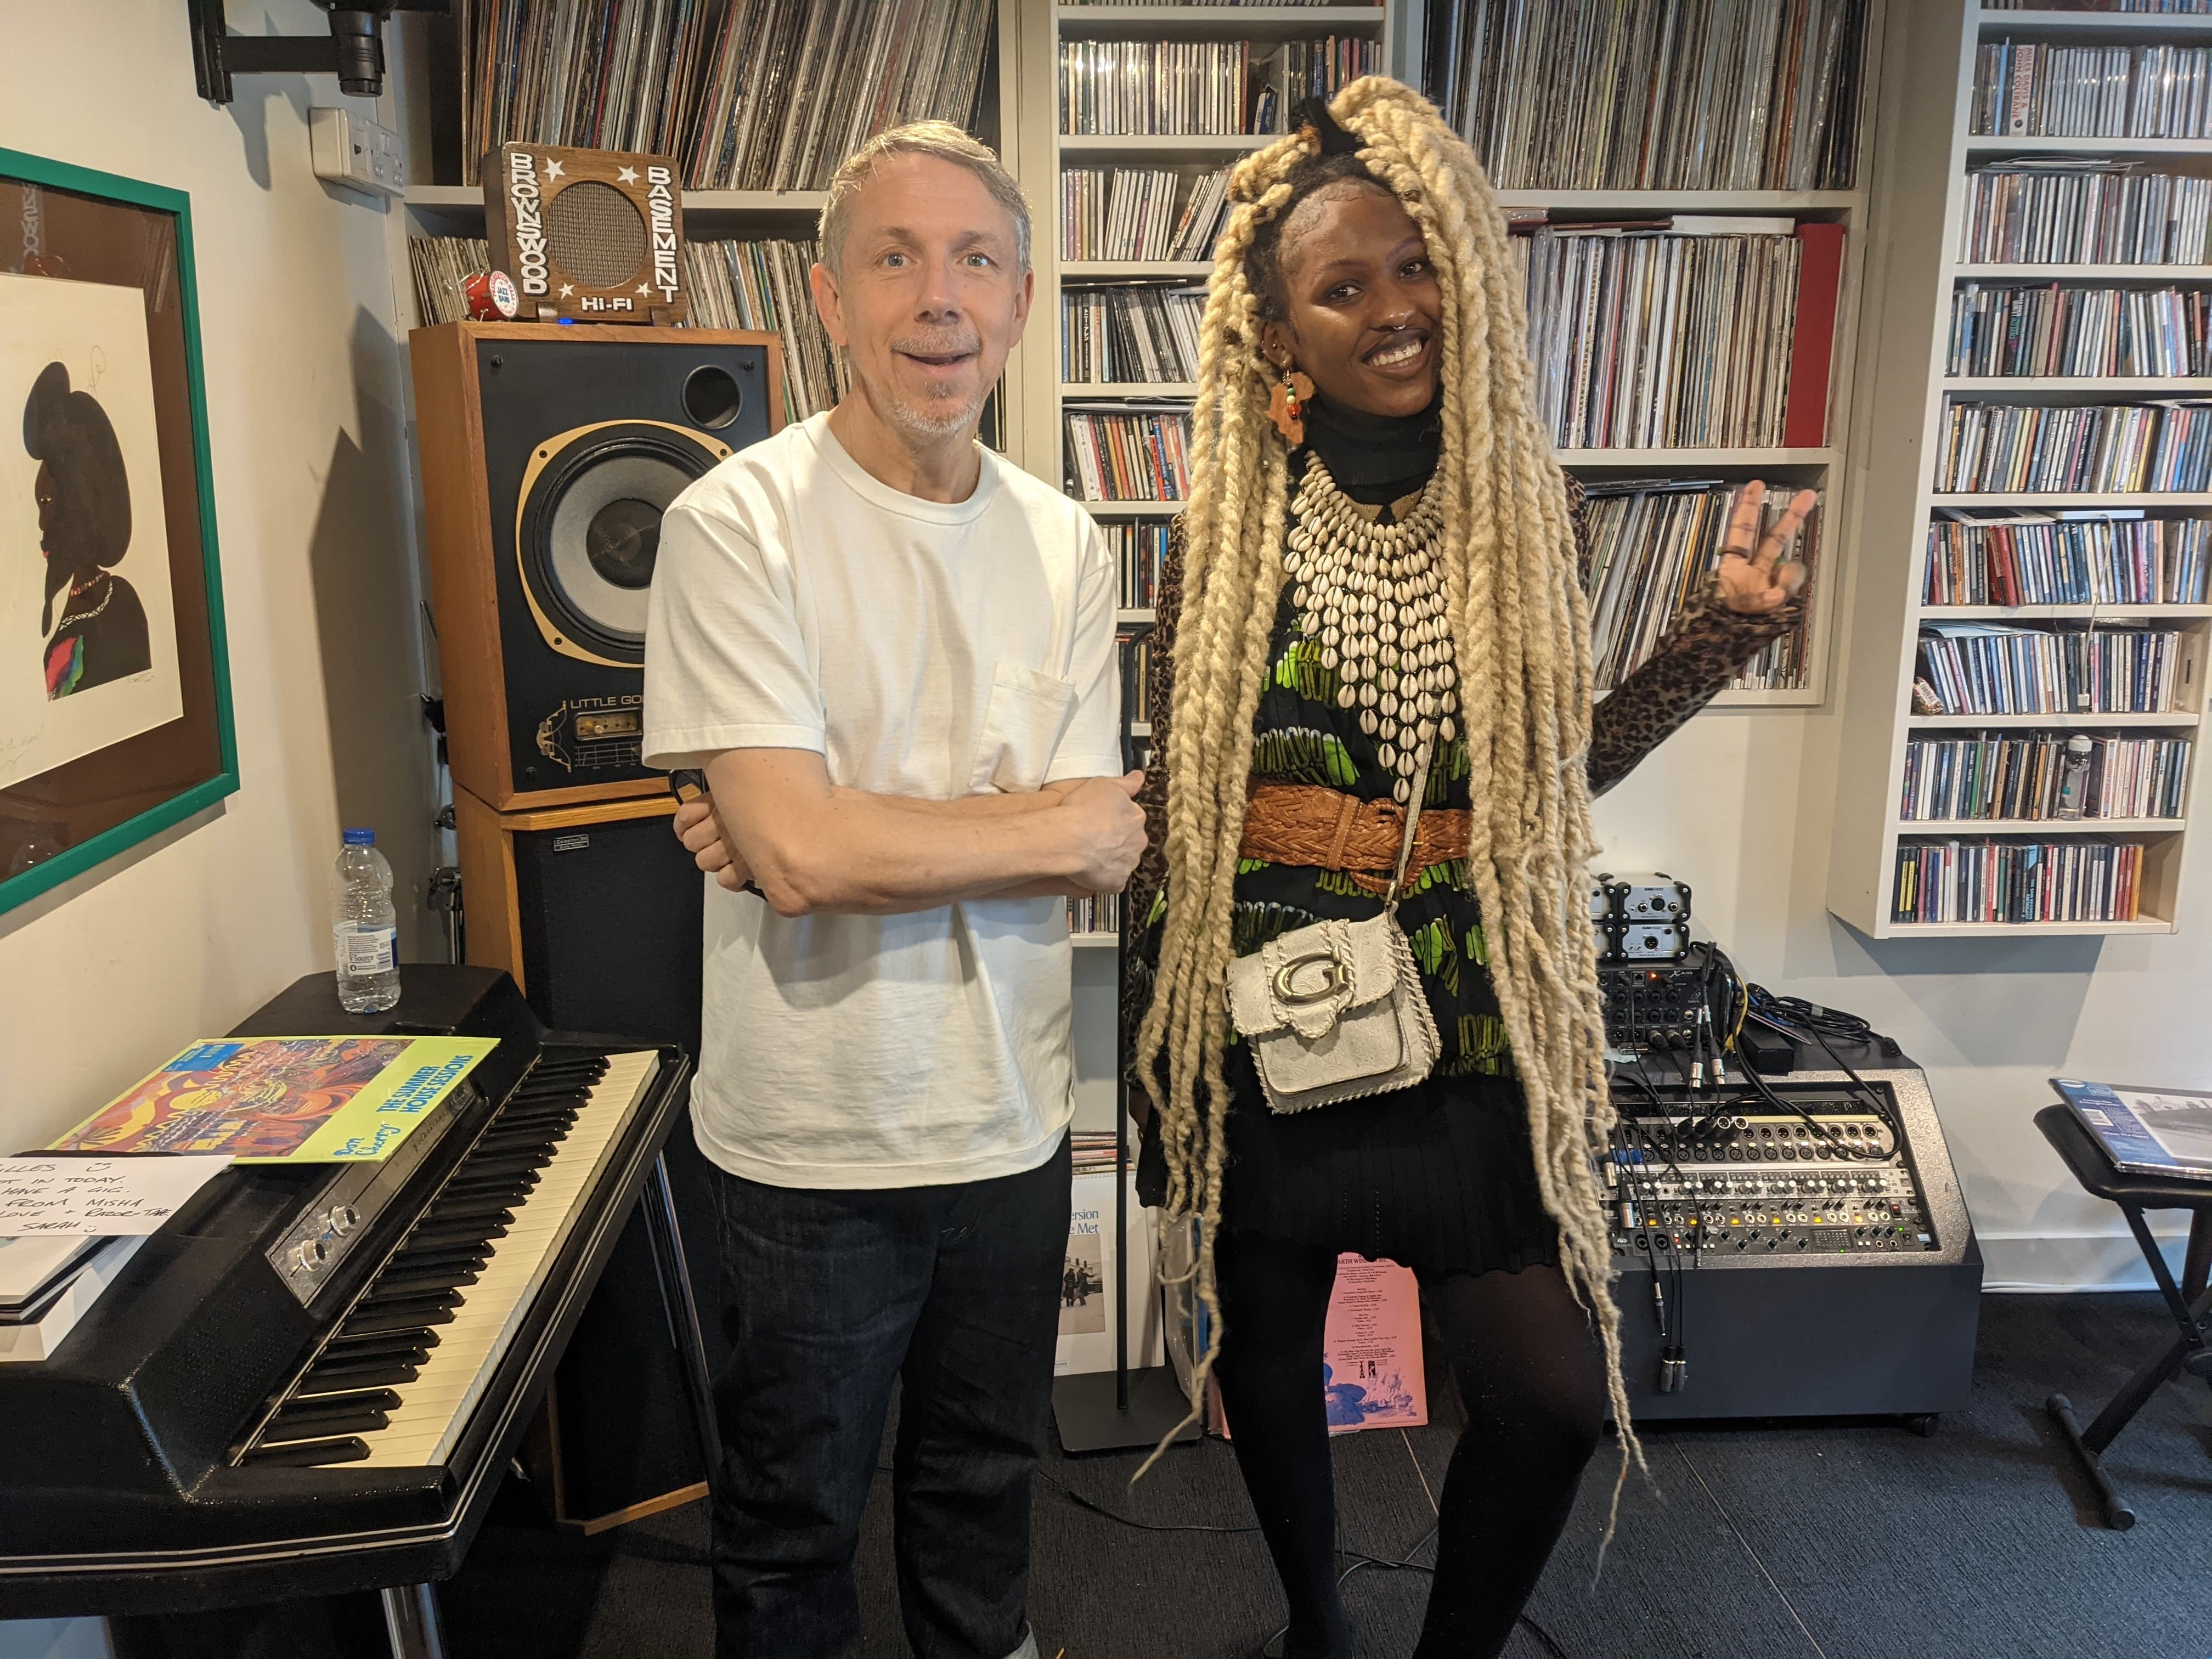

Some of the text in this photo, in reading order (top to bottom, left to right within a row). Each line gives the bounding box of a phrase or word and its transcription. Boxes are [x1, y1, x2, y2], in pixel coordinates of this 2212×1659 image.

[2024, 48, 2033, 72] MILES
[2011, 48, 2024, 119] JOHN COLTRANE
[2022, 75, 2030, 99] DAVIS
[510, 152, 548, 295] BROWNSWOOD
[647, 166, 679, 303] BASEMENT
[497, 286, 509, 296] JAZZ
[580, 296, 633, 311] HI-FI
[571, 695, 644, 709] LITTLE GO
[392, 1066, 441, 1099] SUMMER
[399, 1054, 473, 1113] HOUSE SESSIONS
[332, 1137, 365, 1156] Don
[354, 1123, 402, 1156] Cherry
[5, 1198, 69, 1207] FROM
[1077, 1222, 1099, 1234] Met
